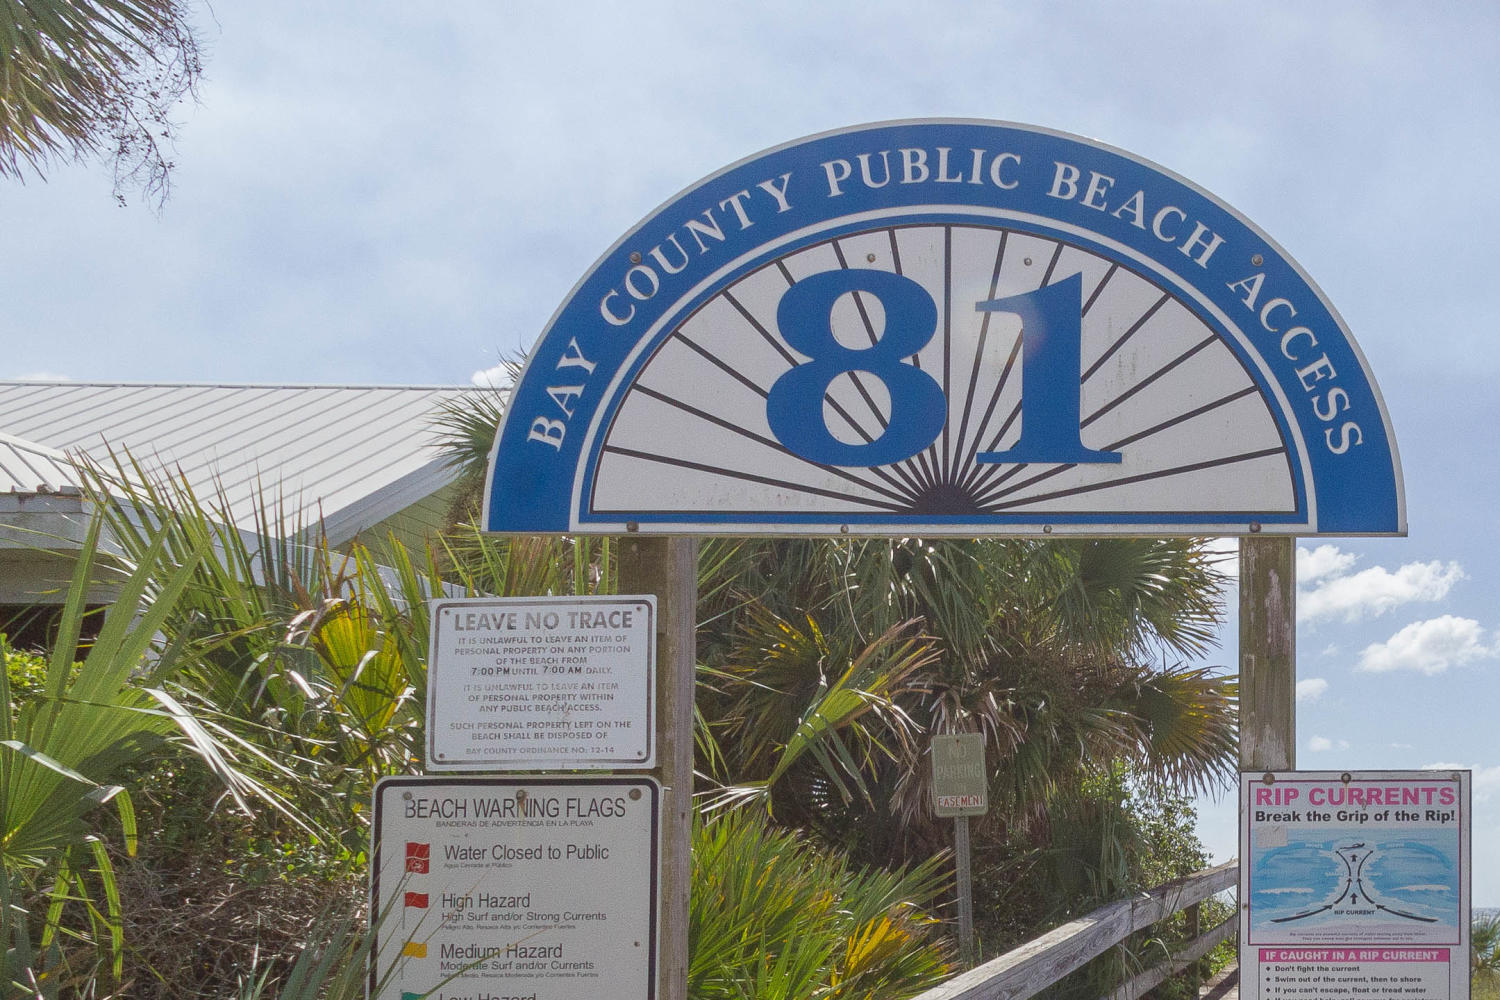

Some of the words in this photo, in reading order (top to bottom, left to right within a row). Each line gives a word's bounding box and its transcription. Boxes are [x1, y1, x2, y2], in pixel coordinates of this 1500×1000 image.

[527, 336, 598, 452] BAY
[600, 172, 794, 326] COUNTY
[820, 147, 1021, 198] PUBLIC
[1046, 161, 1226, 269] BEACH
[1226, 272, 1363, 455] ACCESS
[766, 268, 1122, 467] 81
[455, 613, 517, 631] LEAVE
[525, 612, 559, 630] NO
[568, 611, 632, 629] TRACE
[458, 637, 466, 645] IT
[468, 637, 477, 645] IS
[480, 637, 528, 645] UNLAWFUL
[531, 636, 542, 644] TO
[546, 635, 572, 643] LEAVE
[472, 667, 493, 675] 7:00
[497, 667, 510, 675] PM
[543, 666, 565, 674] 7:00
[568, 666, 582, 674] AM
[503, 732, 531, 740] SHALL
[1256, 788, 1299, 806] RIP
[1309, 787, 1455, 806] CURRENTS
[405, 798, 467, 818] BEACH
[473, 798, 559, 818] WARNING
[566, 798, 626, 818] FLAGS
[1255, 811, 1300, 822] Break
[1306, 811, 1331, 821] the
[1336, 810, 1368, 824] Grip
[1374, 810, 1389, 821] of
[1395, 810, 1420, 821] the
[1425, 810, 1455, 824] Rip!
[444, 845, 487, 860] Water
[492, 844, 542, 860] Closed
[547, 845, 561, 860] to
[566, 844, 609, 860] Public
[442, 893, 473, 912] High
[479, 892, 530, 908] Hazard
[467, 911, 488, 921] Surf
[491, 911, 522, 921] and/or
[526, 911, 560, 923] Strong
[563, 911, 607, 921] Currents
[440, 943, 500, 959] Medium
[506, 943, 562, 958] Hazard
[1265, 951, 1277, 960] IF
[1280, 951, 1329, 960] CAUGHT
[1332, 951, 1345, 960] IN
[1348, 951, 1356, 960] A
[1359, 951, 1379, 960] RIP
[1382, 951, 1439, 960] CURRENT
[491, 961, 513, 970] Surf
[515, 961, 548, 970] and/or
[550, 960, 594, 970] Currents
[1297, 965, 1314, 973] fight
